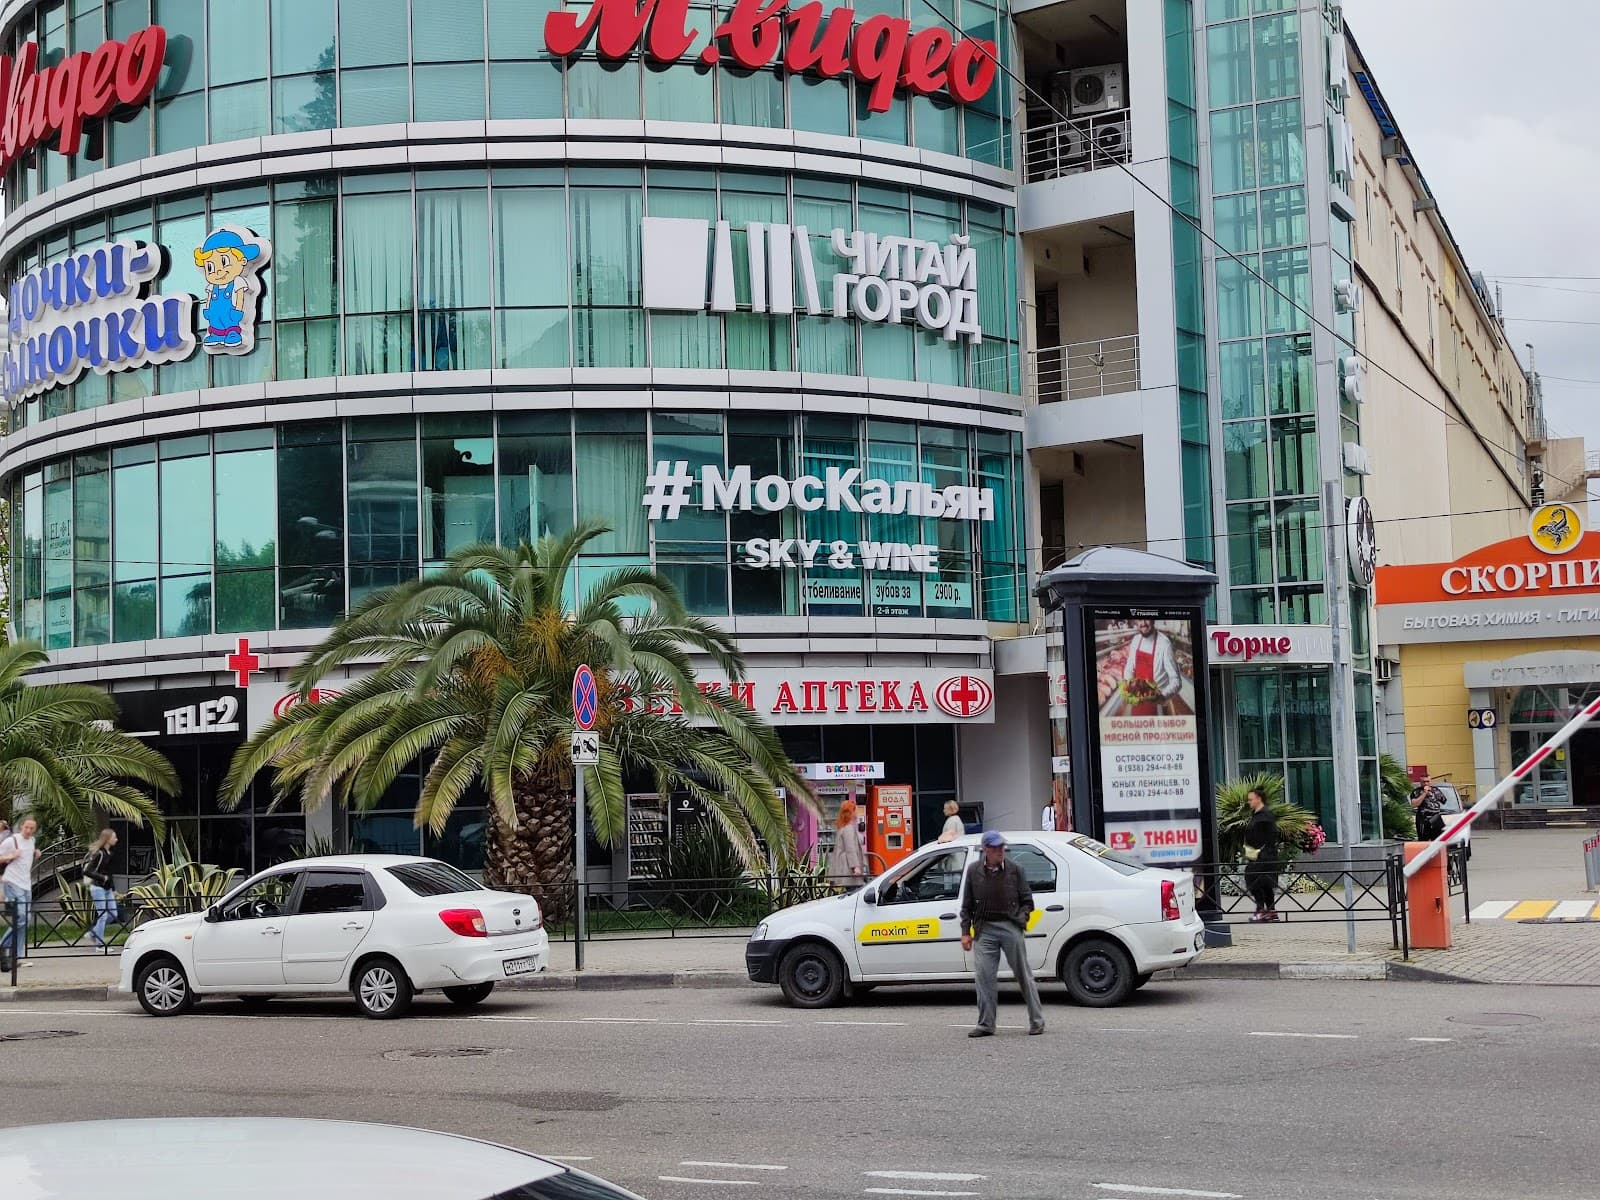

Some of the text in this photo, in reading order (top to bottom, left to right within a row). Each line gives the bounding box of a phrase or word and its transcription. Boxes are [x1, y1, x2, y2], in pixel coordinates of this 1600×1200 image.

[0, 25, 168, 160] видео
[831, 228, 977, 291] ЧИТАЙ
[832, 273, 982, 345] ГОРОД
[642, 460, 995, 521] #МосКальян
[744, 538, 940, 573] SKY & WINE
[875, 581, 900, 602] зубов
[902, 584, 911, 599] за
[934, 583, 953, 600] 2900
[890, 607, 909, 616] этаж
[1402, 613, 1480, 630] БЫТОВАЯ
[1486, 609, 1541, 625] ХИМИЯ
[1211, 631, 1292, 661] Торне
[772, 679, 930, 713] АПТЕКА
[163, 695, 240, 736] TELE2
[1111, 718, 1187, 729] БОЛЬШОЙ ВЫБОР
[1104, 731, 1194, 741] МЯСНОЙ ПРОДУКЦИИ
[1175, 753, 1185, 761] 29
[1111, 780, 1136, 788] ЮНЫХ
[882, 795, 905, 804] ВОДА
[1144, 829, 1198, 846] ТКАНИ
[871, 925, 908, 937] maxim
